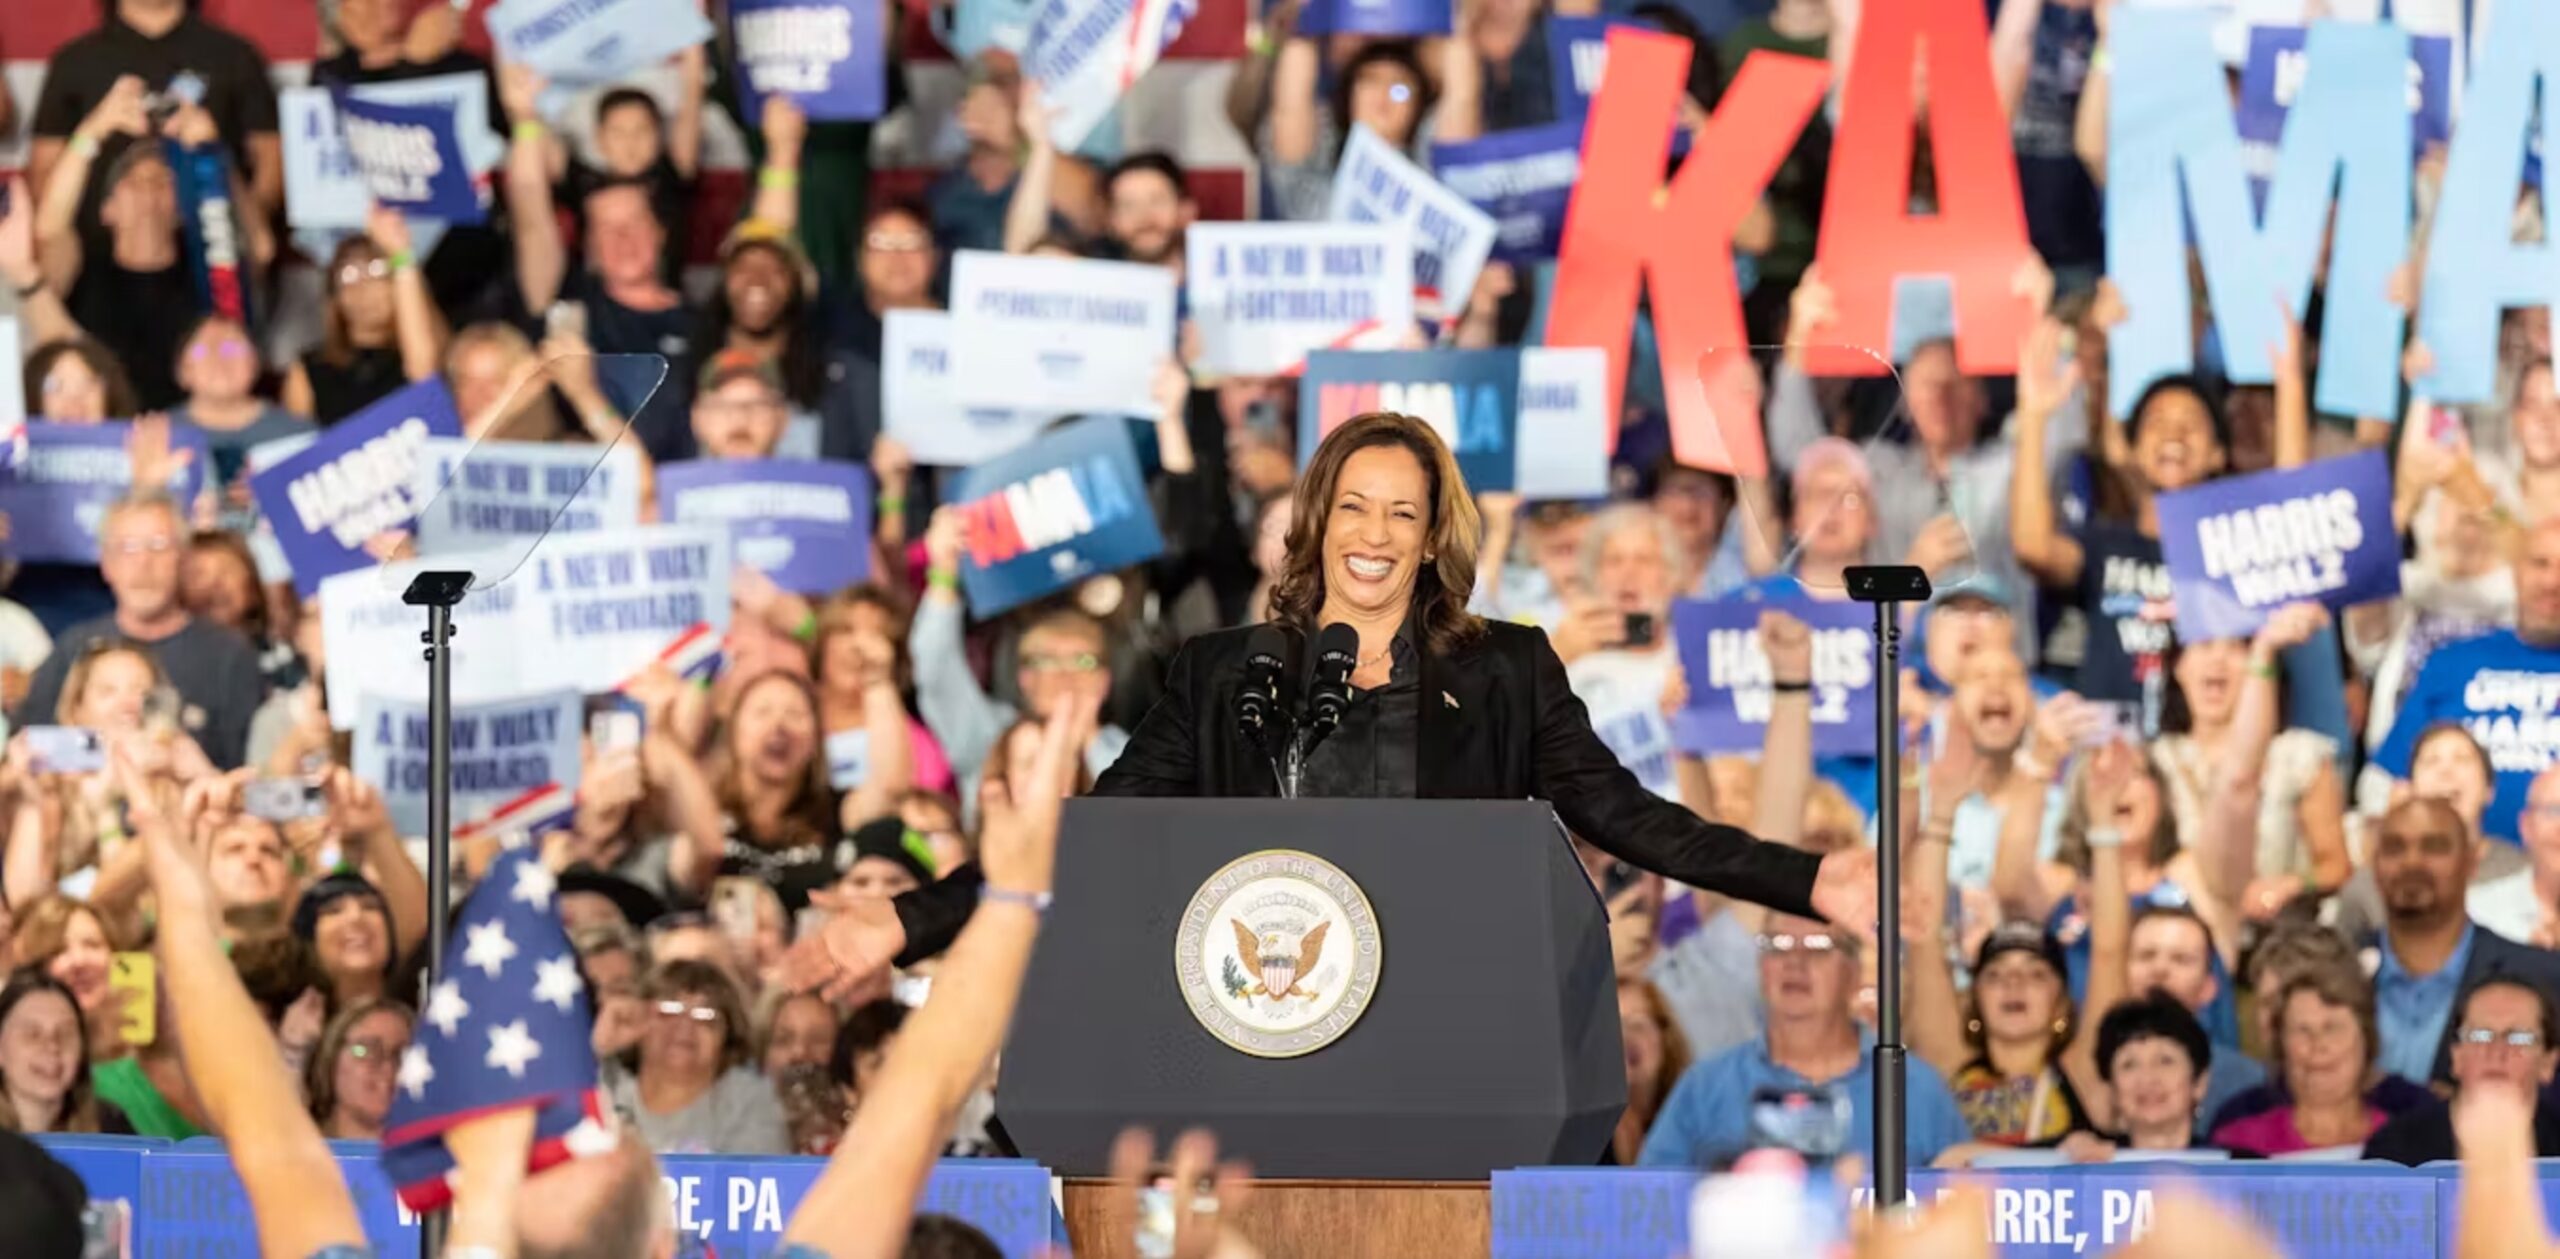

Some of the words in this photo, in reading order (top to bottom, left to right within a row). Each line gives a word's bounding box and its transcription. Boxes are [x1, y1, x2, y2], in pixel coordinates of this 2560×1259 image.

[2197, 487, 2364, 580] HARRIS
[565, 550, 634, 588] NEW
[2231, 551, 2348, 607] WALZ
[1708, 627, 1872, 690] HAIS
[404, 713, 479, 750] NW
[489, 705, 558, 747] WAY
[386, 751, 550, 793] FOWARD
[1249, 861, 1271, 875] OF
[1283, 860, 1316, 877] THE
[1181, 872, 1238, 986] PRESIDENT
[1324, 874, 1377, 955] UNITED
[1311, 970, 1374, 1043] STATES
[728, 1177, 783, 1232] PA
